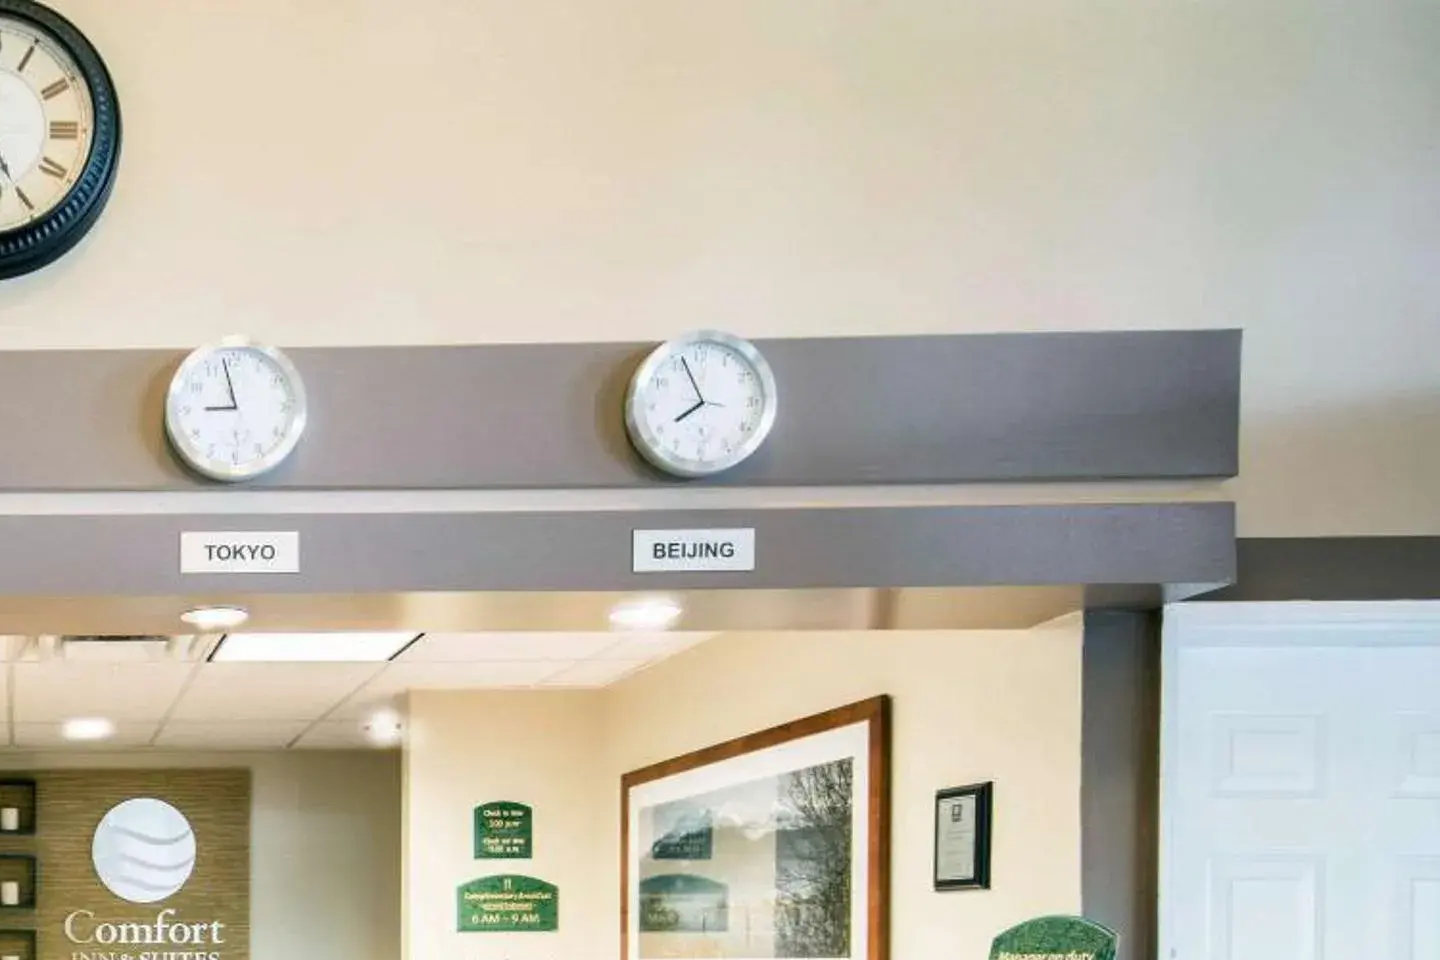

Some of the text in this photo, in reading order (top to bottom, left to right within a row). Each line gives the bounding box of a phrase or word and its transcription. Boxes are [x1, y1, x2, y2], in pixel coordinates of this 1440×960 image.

[203, 544, 276, 561] TOKYO
[652, 541, 736, 560] BEIJING
[64, 908, 226, 944] Comfort
